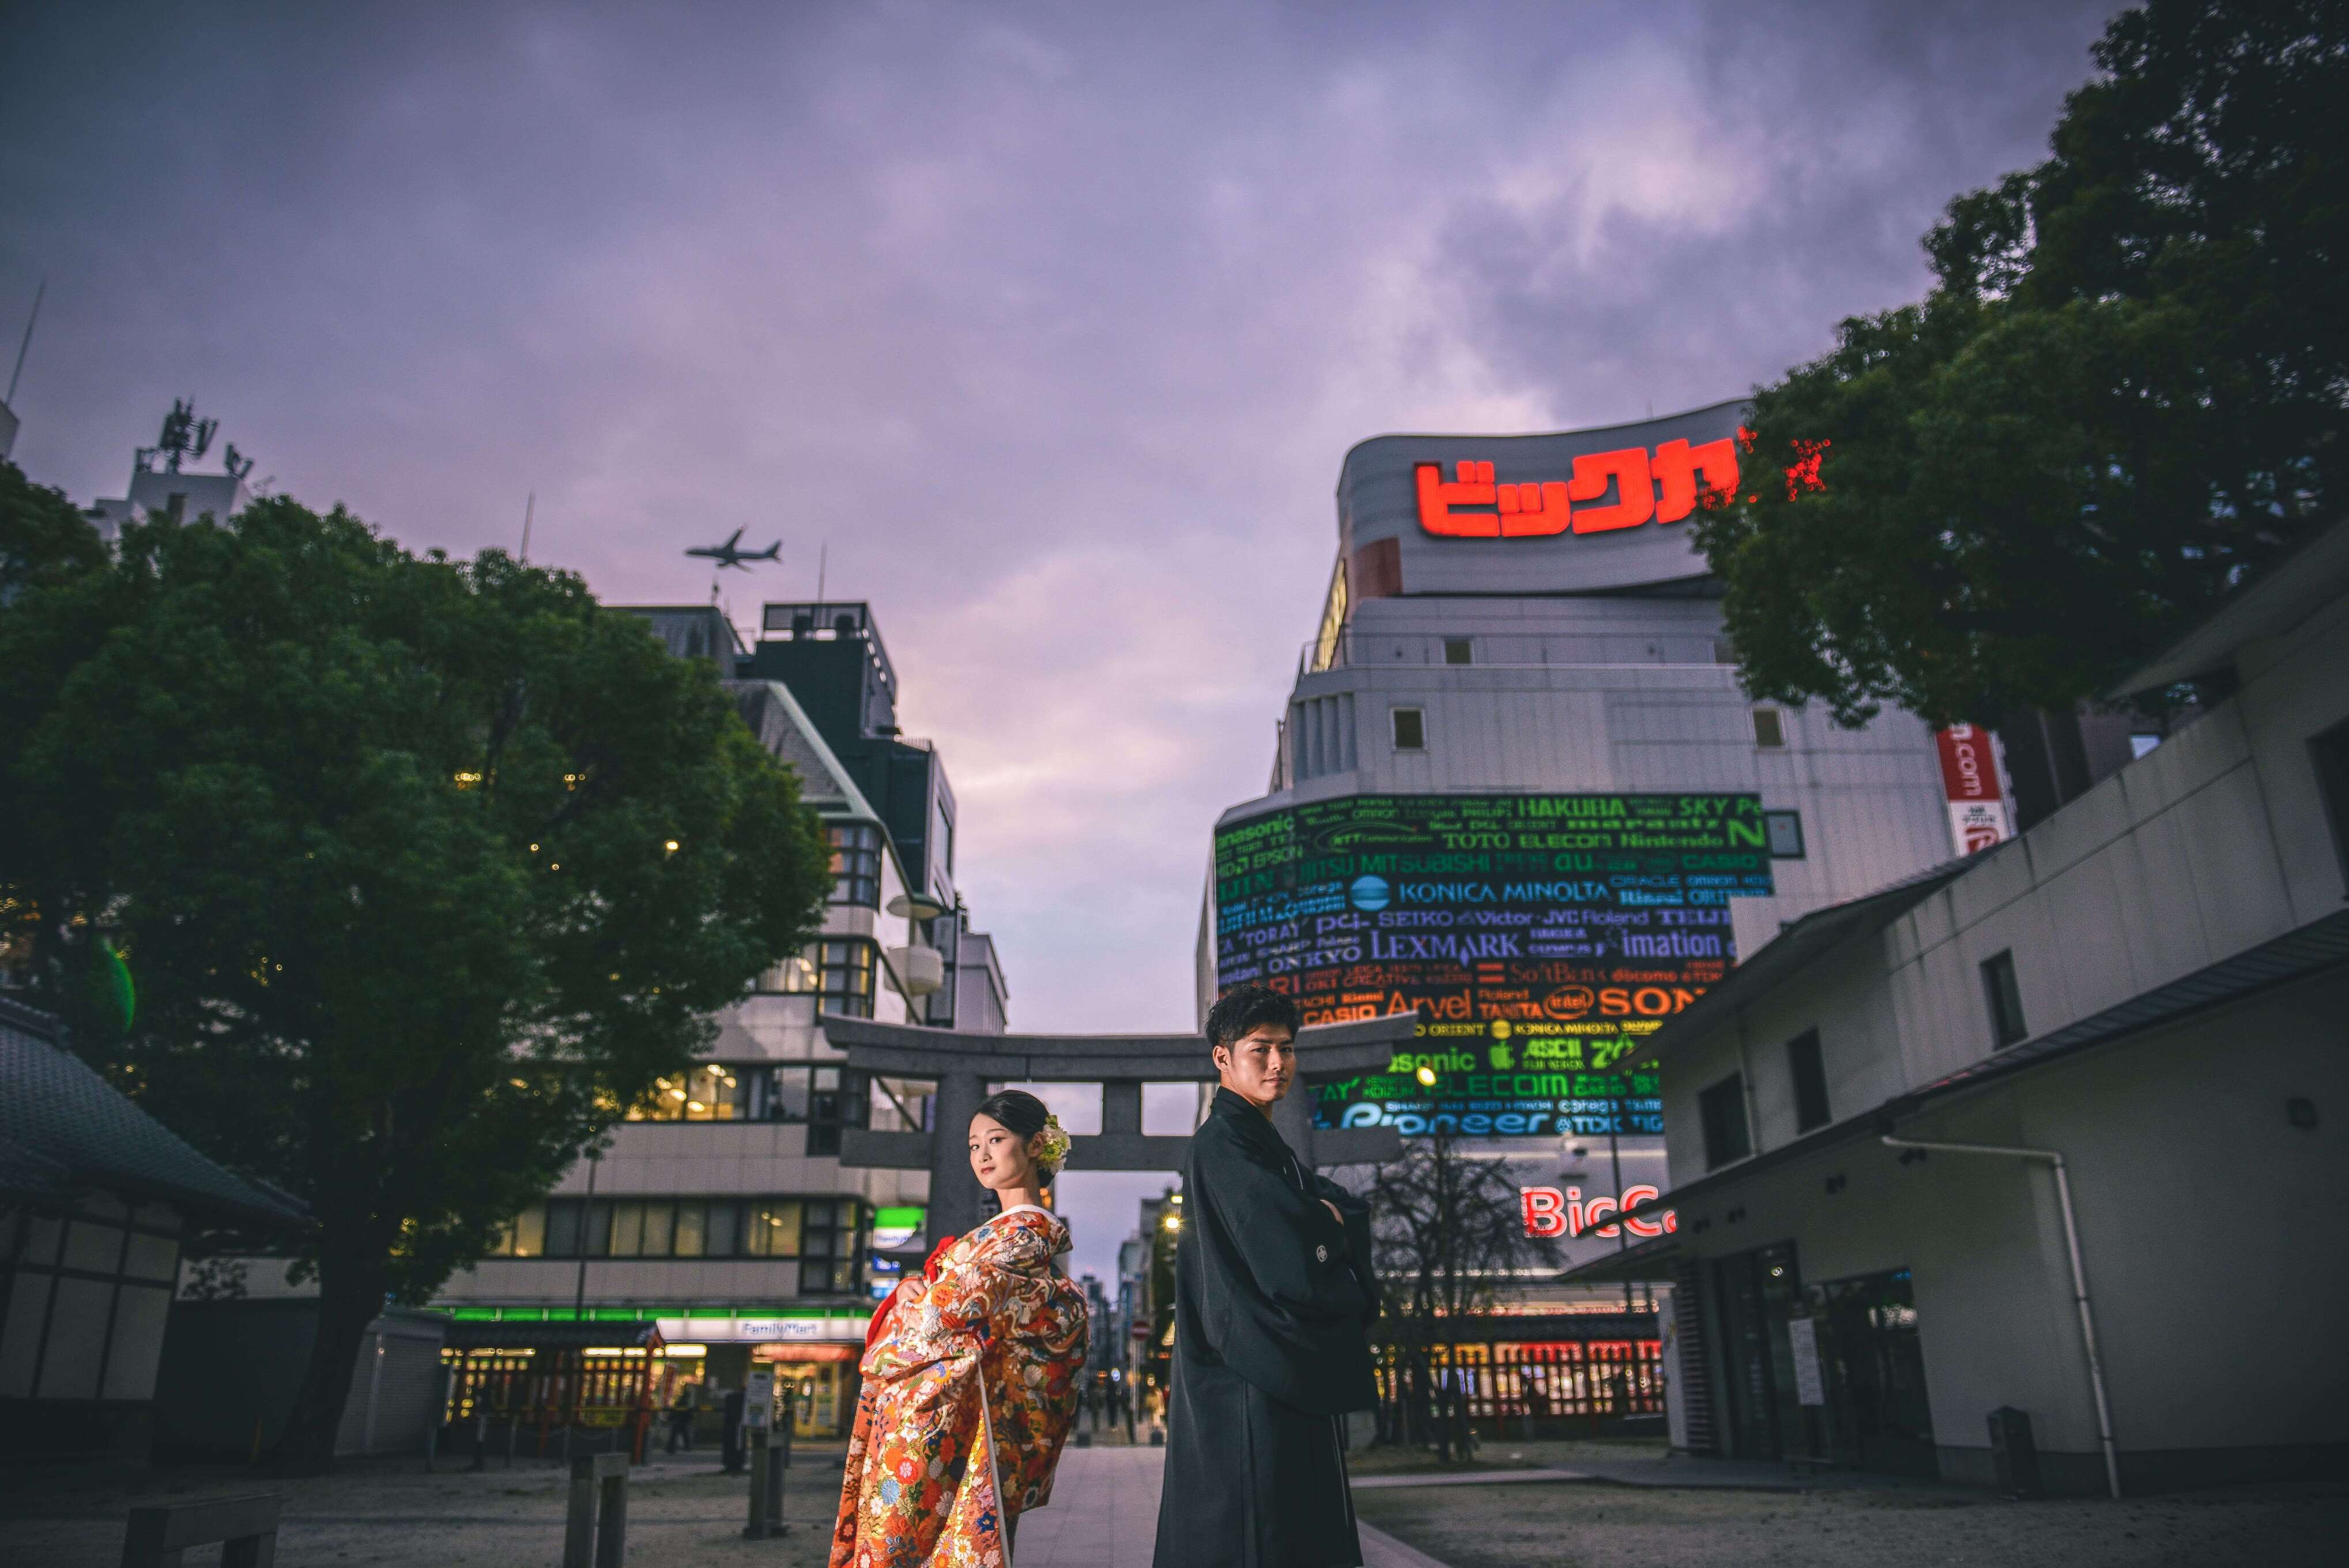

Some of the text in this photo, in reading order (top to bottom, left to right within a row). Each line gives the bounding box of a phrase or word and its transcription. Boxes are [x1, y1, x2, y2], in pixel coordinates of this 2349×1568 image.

[1679, 797, 1729, 817] SKY
[1441, 831, 1510, 849] TOTO
[1620, 830, 1724, 848] Nintendo
[1359, 853, 1490, 874] MITSUBISHI
[1609, 875, 1680, 888] ORACLE
[1398, 880, 1614, 904] KONICA MINOLTA
[1377, 910, 1453, 928] SEIKO
[1369, 928, 1526, 968] LEXMARK
[1622, 928, 1722, 958] imation
[1268, 945, 1363, 974] ONKYO
[1385, 987, 1473, 1020] Arvel
[1303, 1004, 1377, 1026] CASIO
[1428, 1023, 1486, 1036] ORIENT
[1514, 1022, 1620, 1035] KONICA MINOLTA
[1338, 1100, 1551, 1135] Pioneer
[1571, 1115, 1624, 1133] TDK
[741, 1321, 818, 1337] FamilyMart
